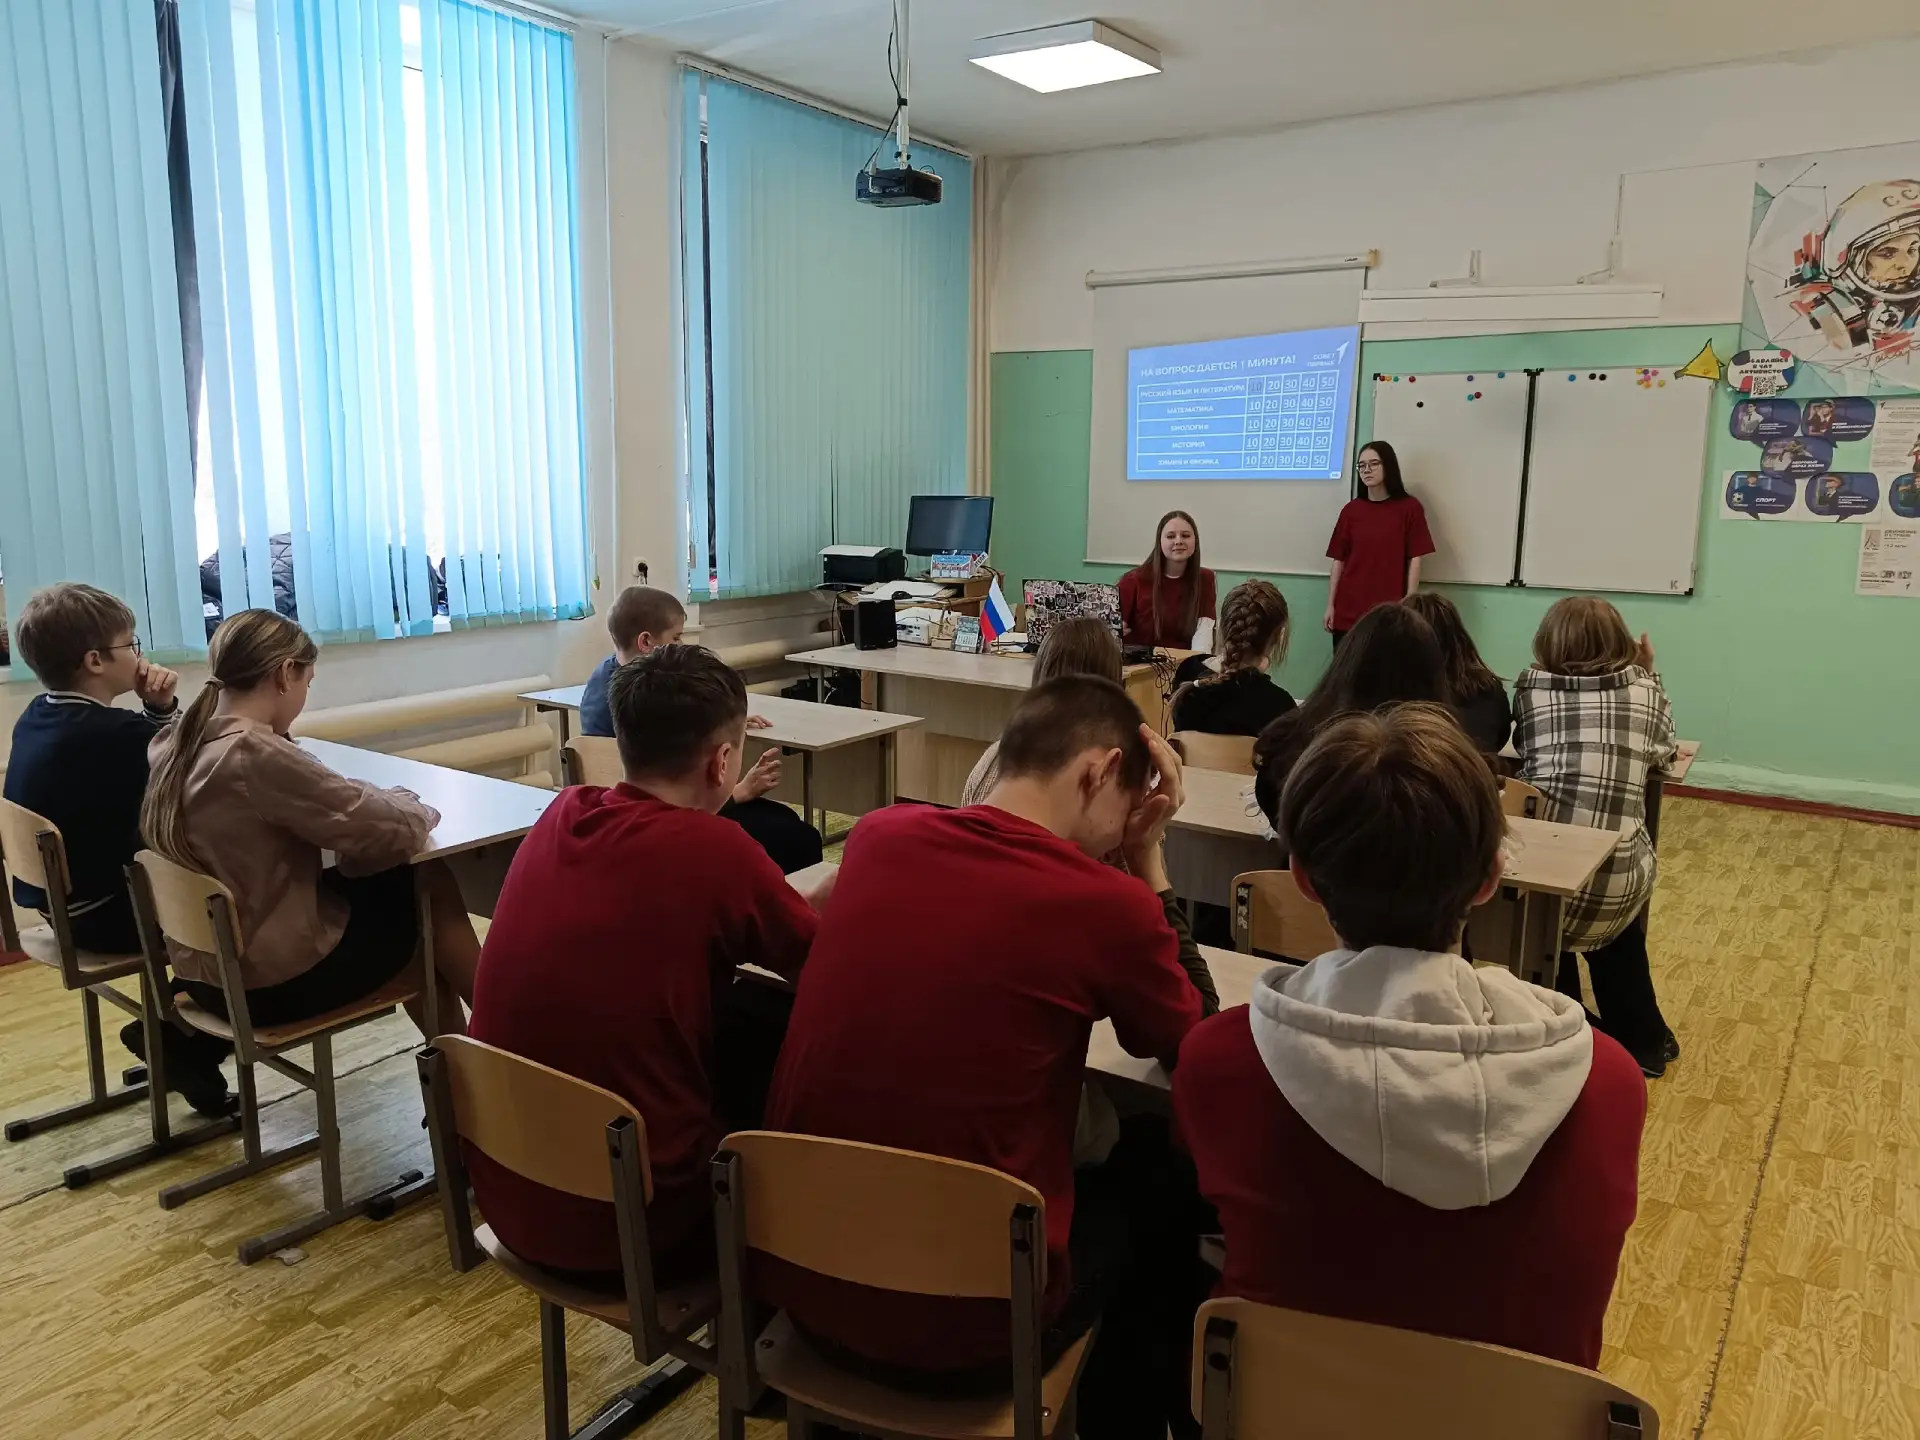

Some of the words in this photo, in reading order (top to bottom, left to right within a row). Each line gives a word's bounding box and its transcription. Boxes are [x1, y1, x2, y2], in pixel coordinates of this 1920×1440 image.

[1141, 369, 1153, 377] НА
[1155, 365, 1195, 376] ВОПРОС
[1197, 361, 1237, 372] ДАЕТСЯ
[1247, 354, 1296, 368] МИНУТА!
[1267, 380, 1280, 390] 20
[1285, 379, 1298, 389] 30
[1303, 378, 1316, 388] 40
[1321, 377, 1335, 388] 50
[1140, 389, 1171, 398] РУССКИЙ
[1172, 387, 1192, 396] ЯЗЫК
[1200, 385, 1245, 395] ЛИТЕРАТУРА
[1166, 405, 1214, 414] МАТЕМАТИКА
[1249, 401, 1261, 411] 10
[1266, 400, 1278, 410] 20
[1284, 399, 1296, 409] 30
[1301, 398, 1314, 408] 40
[1319, 397, 1333, 407] 50
[1170, 424, 1209, 432] БИОЛОГИЯ
[1248, 419, 1260, 429] 10
[1265, 418, 1277, 429] 20
[1282, 418, 1295, 428] 30
[1299, 417, 1312, 427] 40
[1317, 416, 1331, 427] 50
[1172, 441, 1206, 449] ИСТОРИЯ
[1246, 438, 1258, 448] 10
[1263, 437, 1276, 447] 20
[1280, 436, 1293, 447] 30
[1297, 436, 1310, 446] 40
[1315, 436, 1328, 446] 50
[1189, 458, 1220, 466] ФИЗИКА
[1245, 456, 1258, 466] 10
[1262, 456, 1274, 466] 20
[1279, 455, 1291, 465] 30
[1296, 455, 1309, 465] 40
[1314, 455, 1327, 465] 50
